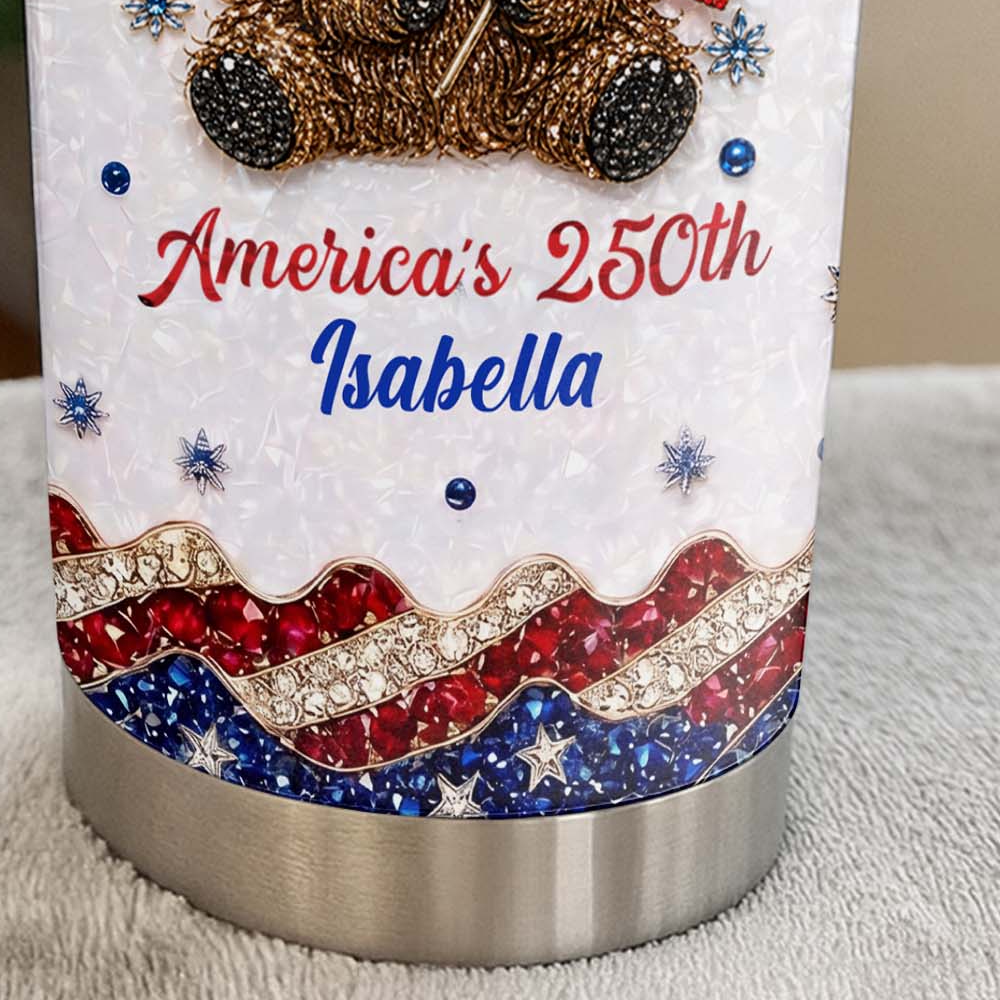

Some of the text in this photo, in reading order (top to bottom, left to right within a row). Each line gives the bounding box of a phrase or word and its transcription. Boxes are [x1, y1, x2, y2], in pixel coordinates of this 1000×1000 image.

[138, 199, 772, 308] America's 250th
[310, 318, 603, 416] Isabella
